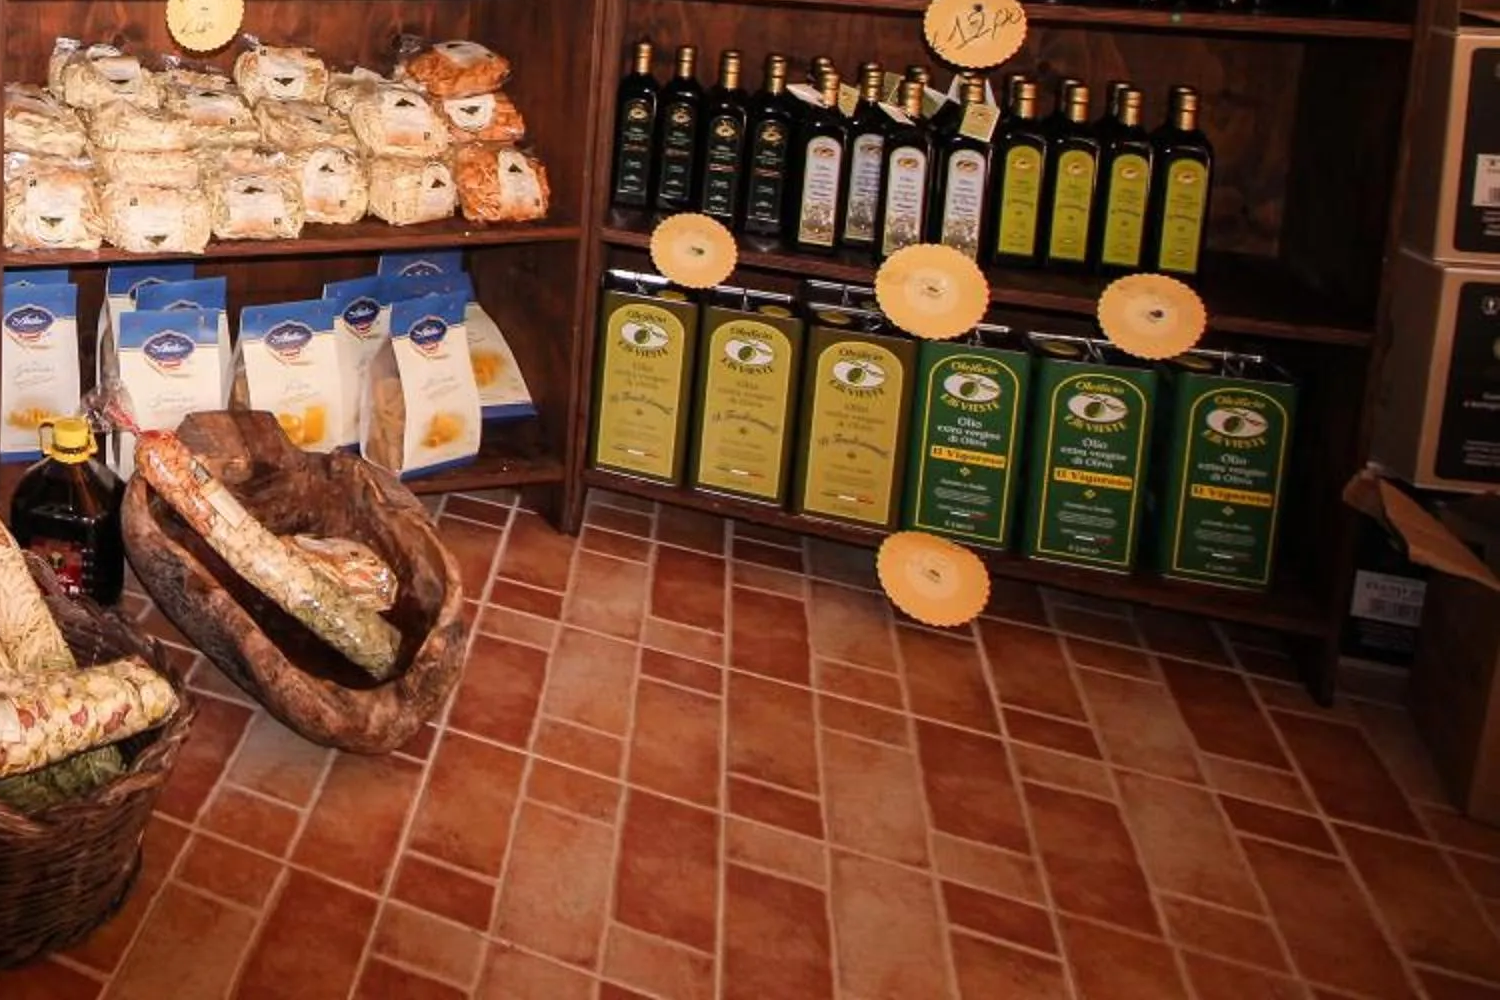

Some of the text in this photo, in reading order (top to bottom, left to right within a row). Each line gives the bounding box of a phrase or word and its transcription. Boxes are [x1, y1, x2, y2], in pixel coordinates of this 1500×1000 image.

[957, 416, 983, 429] Olio
[1081, 437, 1108, 450] Olio
[1220, 453, 1248, 466] Olio
